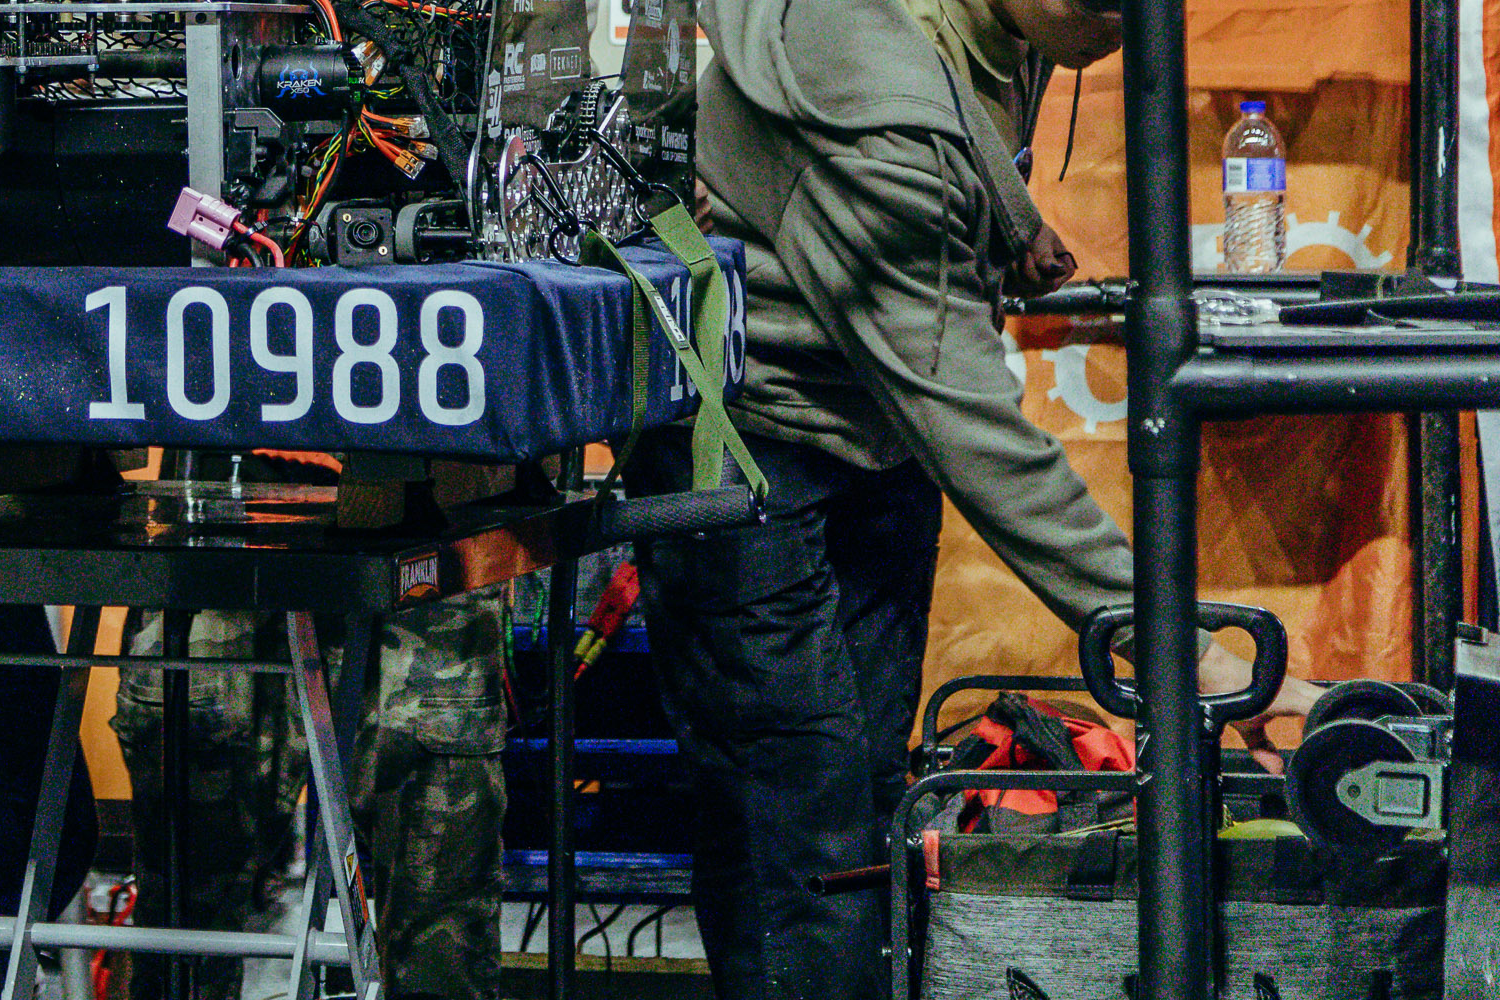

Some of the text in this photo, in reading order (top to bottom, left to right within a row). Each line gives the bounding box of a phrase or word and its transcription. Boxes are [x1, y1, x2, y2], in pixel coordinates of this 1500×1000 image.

[504, 42, 526, 76] RC
[276, 78, 323, 89] KRAKEN
[84, 285, 486, 426] 10988
[399, 556, 438, 596] FRANKLIN
